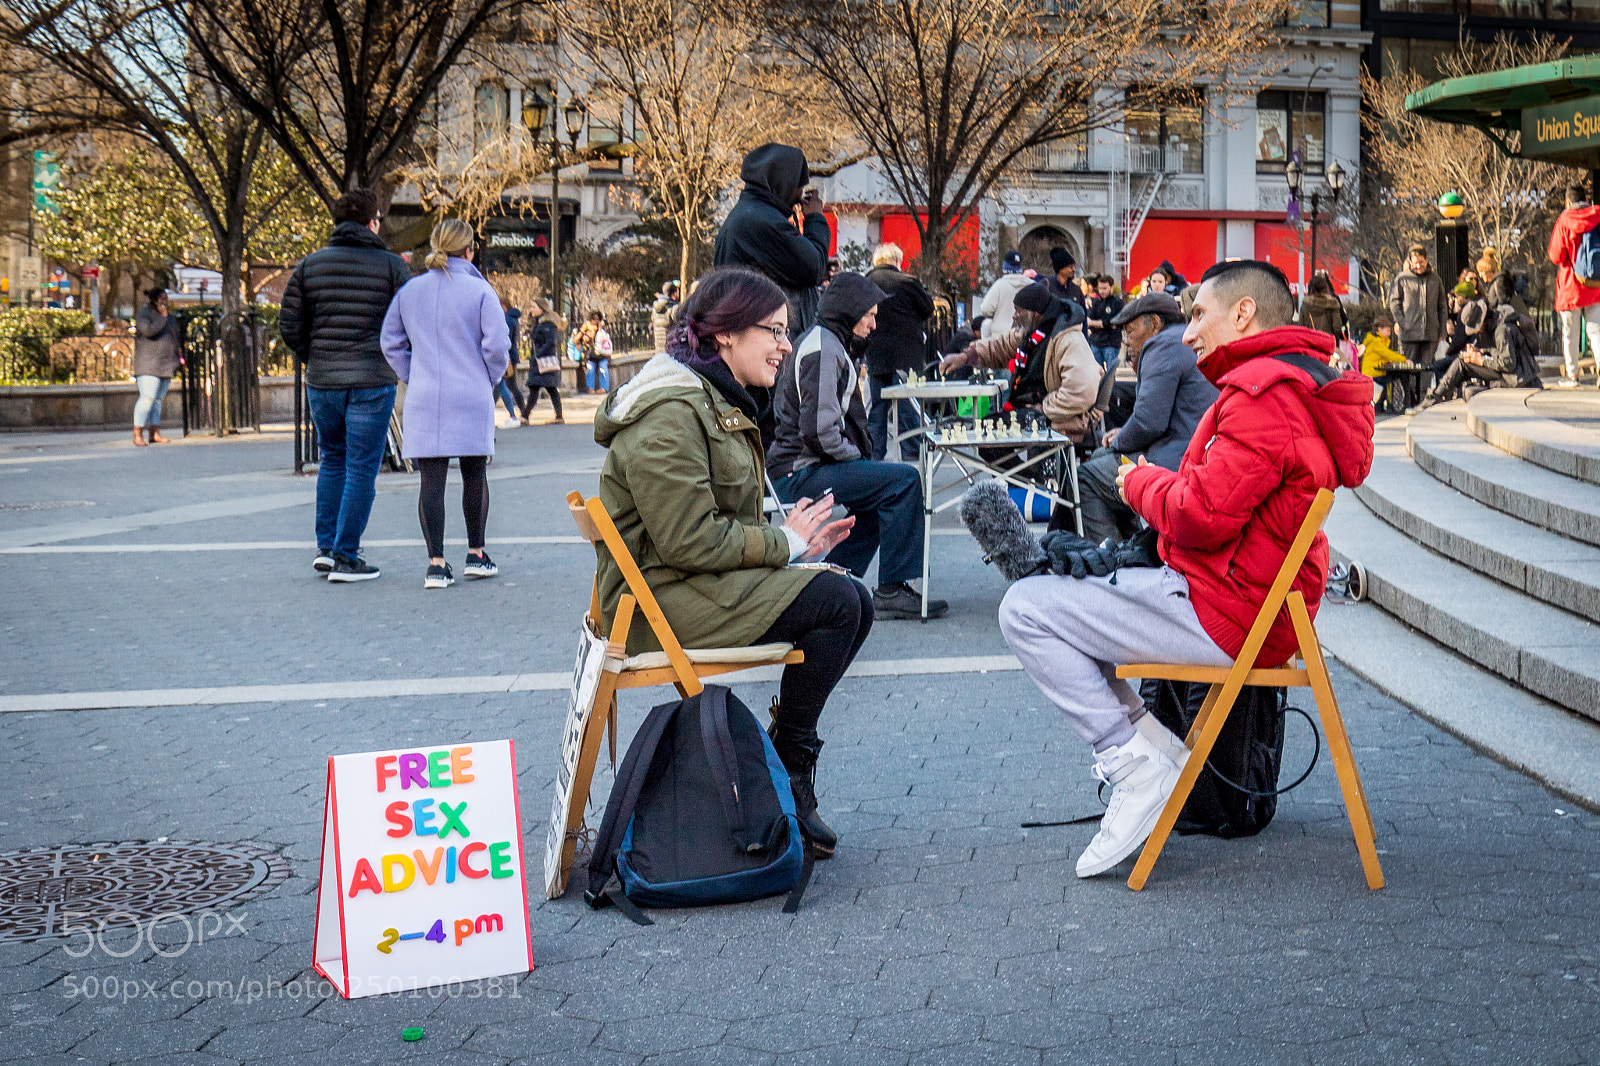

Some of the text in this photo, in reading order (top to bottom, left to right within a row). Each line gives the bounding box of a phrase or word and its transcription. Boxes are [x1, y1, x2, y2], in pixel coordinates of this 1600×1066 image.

[1537, 116, 1570, 142] Union
[491, 233, 535, 247] Reebok
[375, 746, 476, 793] FREE
[384, 798, 471, 839] SEX
[349, 841, 515, 899] ADVICE
[454, 912, 504, 947] pm
